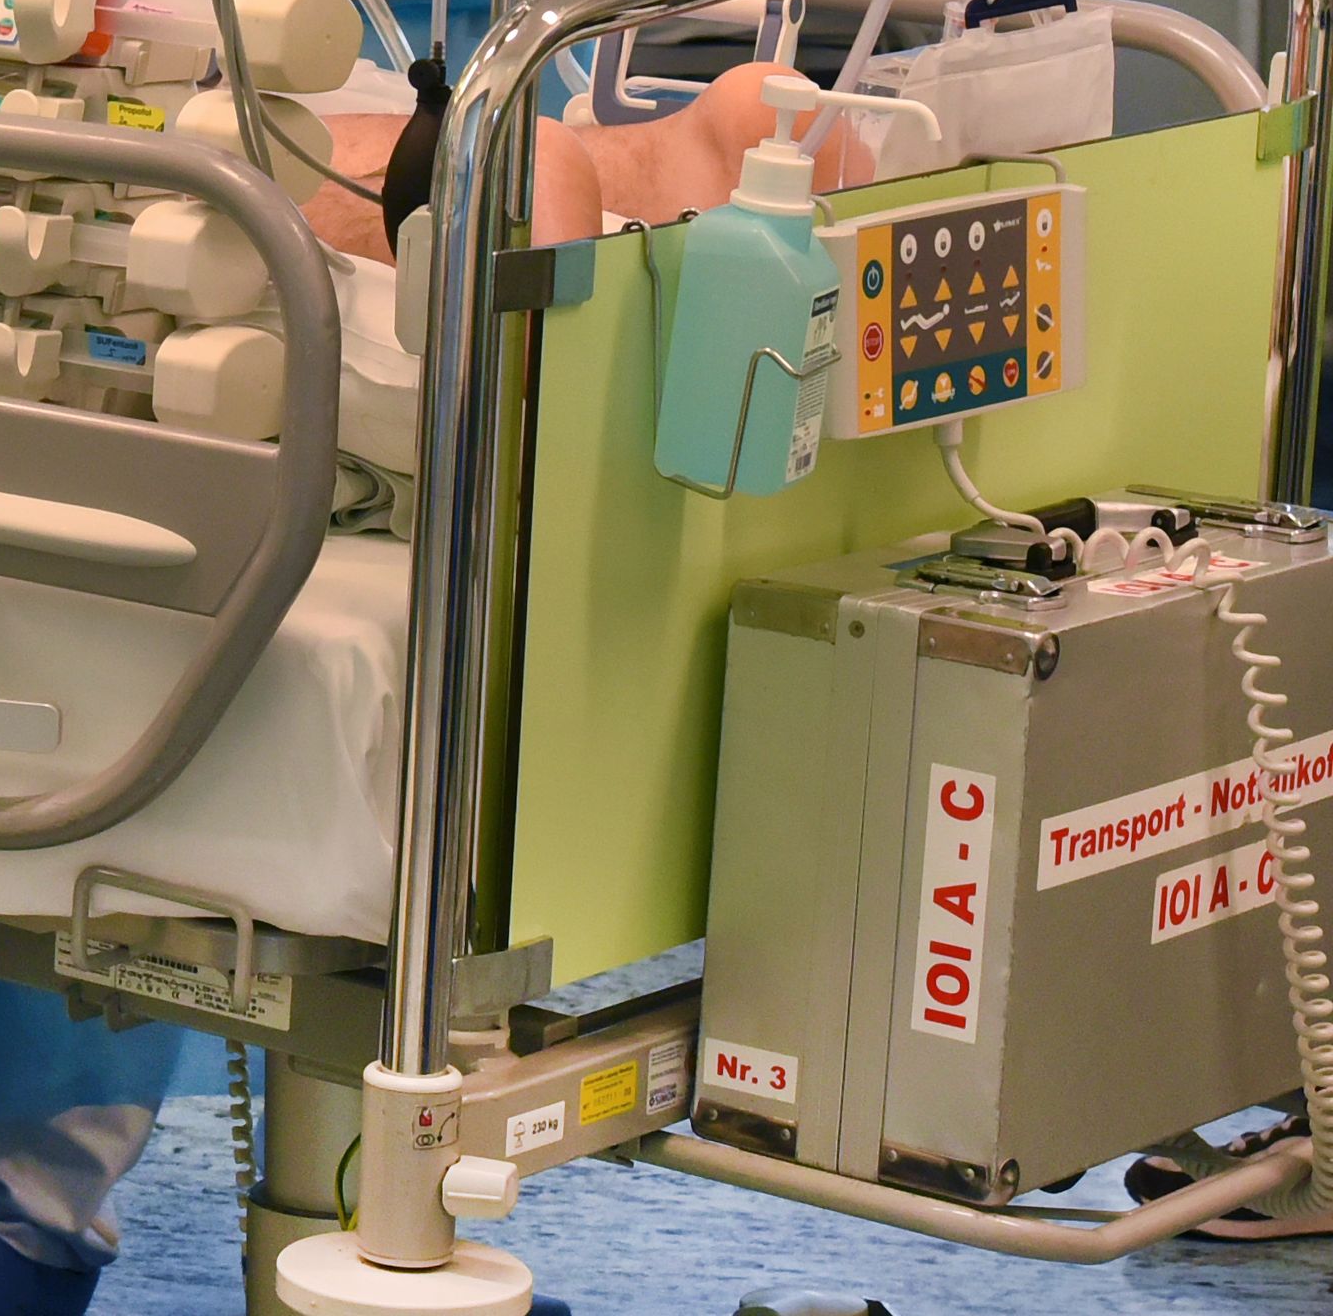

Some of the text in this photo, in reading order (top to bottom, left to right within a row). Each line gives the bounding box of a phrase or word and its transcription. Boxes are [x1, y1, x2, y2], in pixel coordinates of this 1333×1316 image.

[939, 779, 986, 821] C
[1050, 792, 1186, 867] Transport
[1193, 804, 1203, 814] -
[932, 882, 978, 926] A
[1208, 865, 1230, 914] A
[716, 1052, 759, 1085] Nr.
[769, 1065, 787, 1090] 3
[532, 1119, 547, 1136] 230
